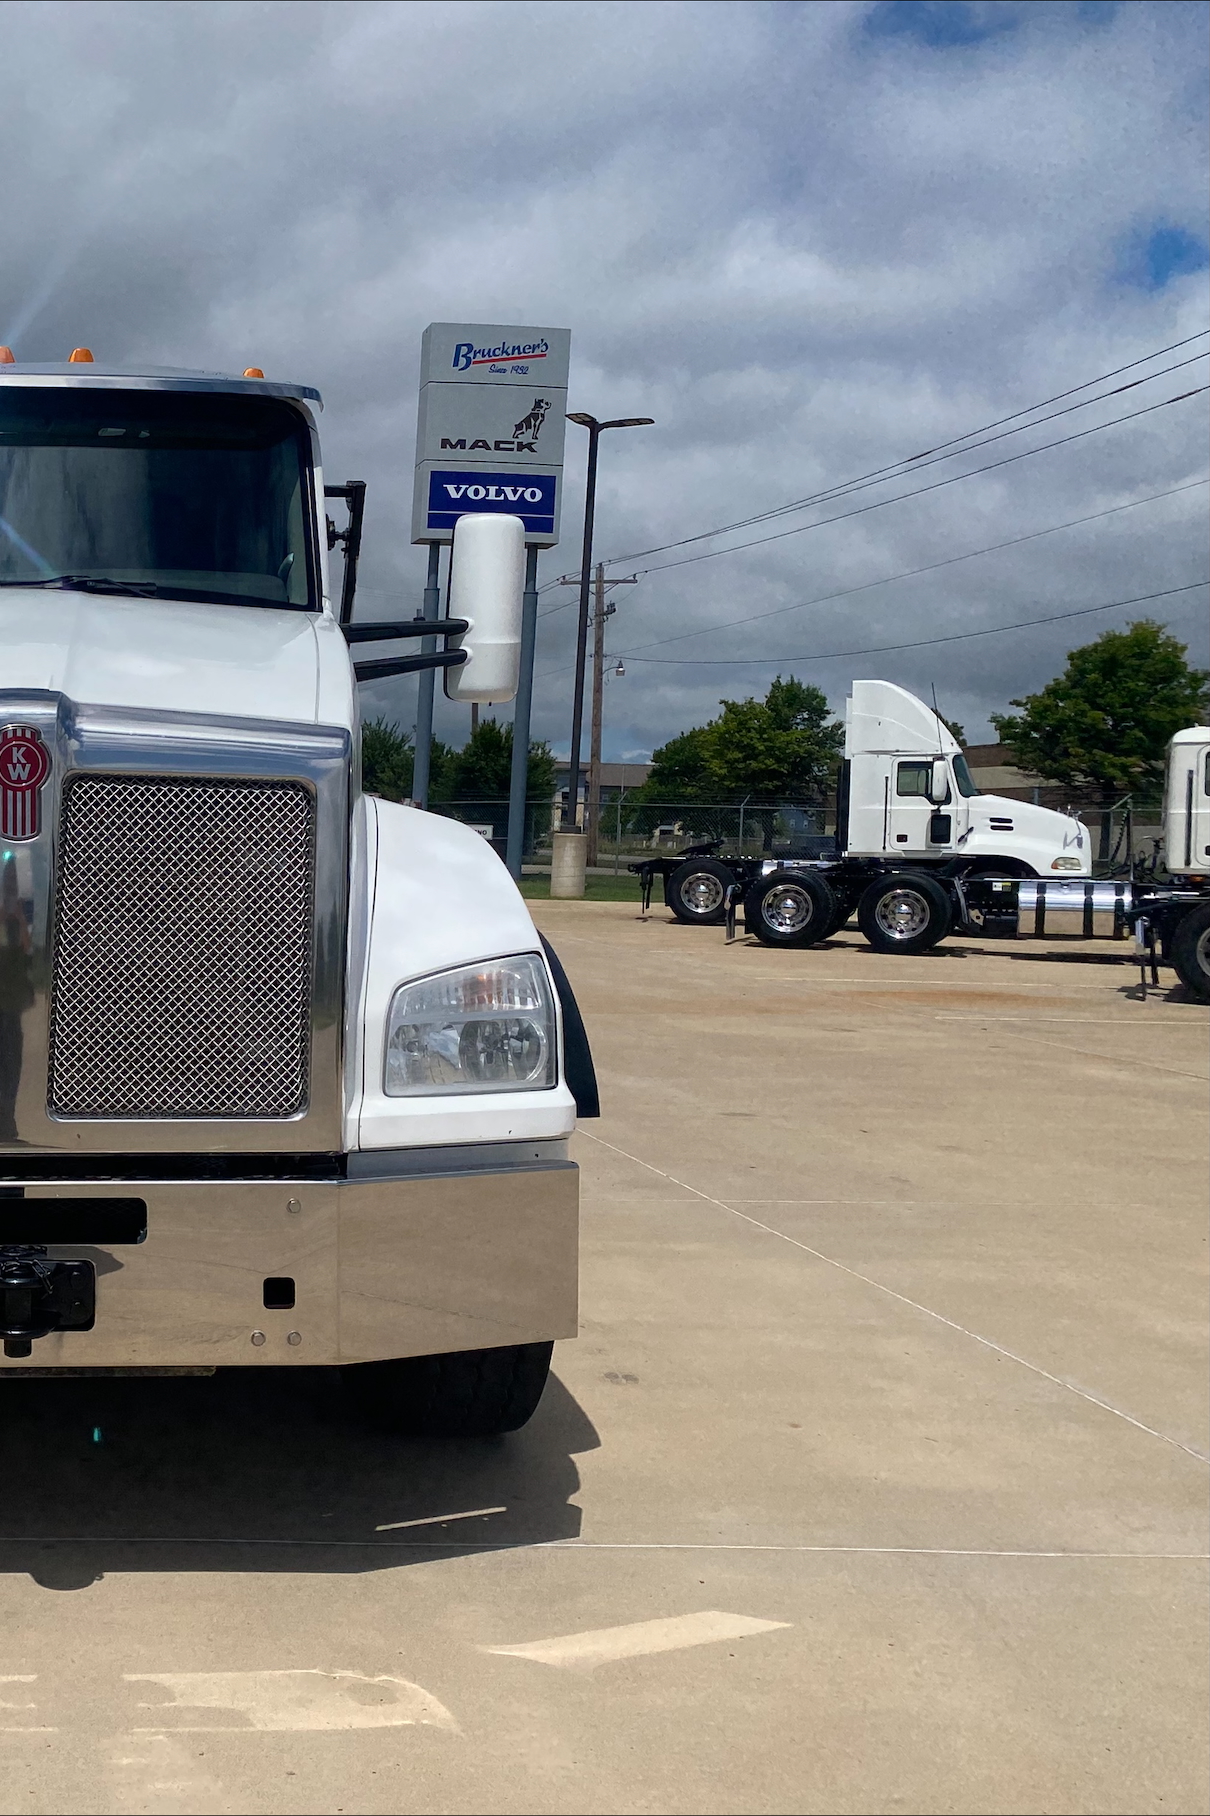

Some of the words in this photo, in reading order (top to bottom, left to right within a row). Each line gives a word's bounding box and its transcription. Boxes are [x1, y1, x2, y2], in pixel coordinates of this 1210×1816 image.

[452, 339, 549, 371] Bruckner's
[440, 438, 538, 453] MACK
[442, 484, 543, 503] VOLVO
